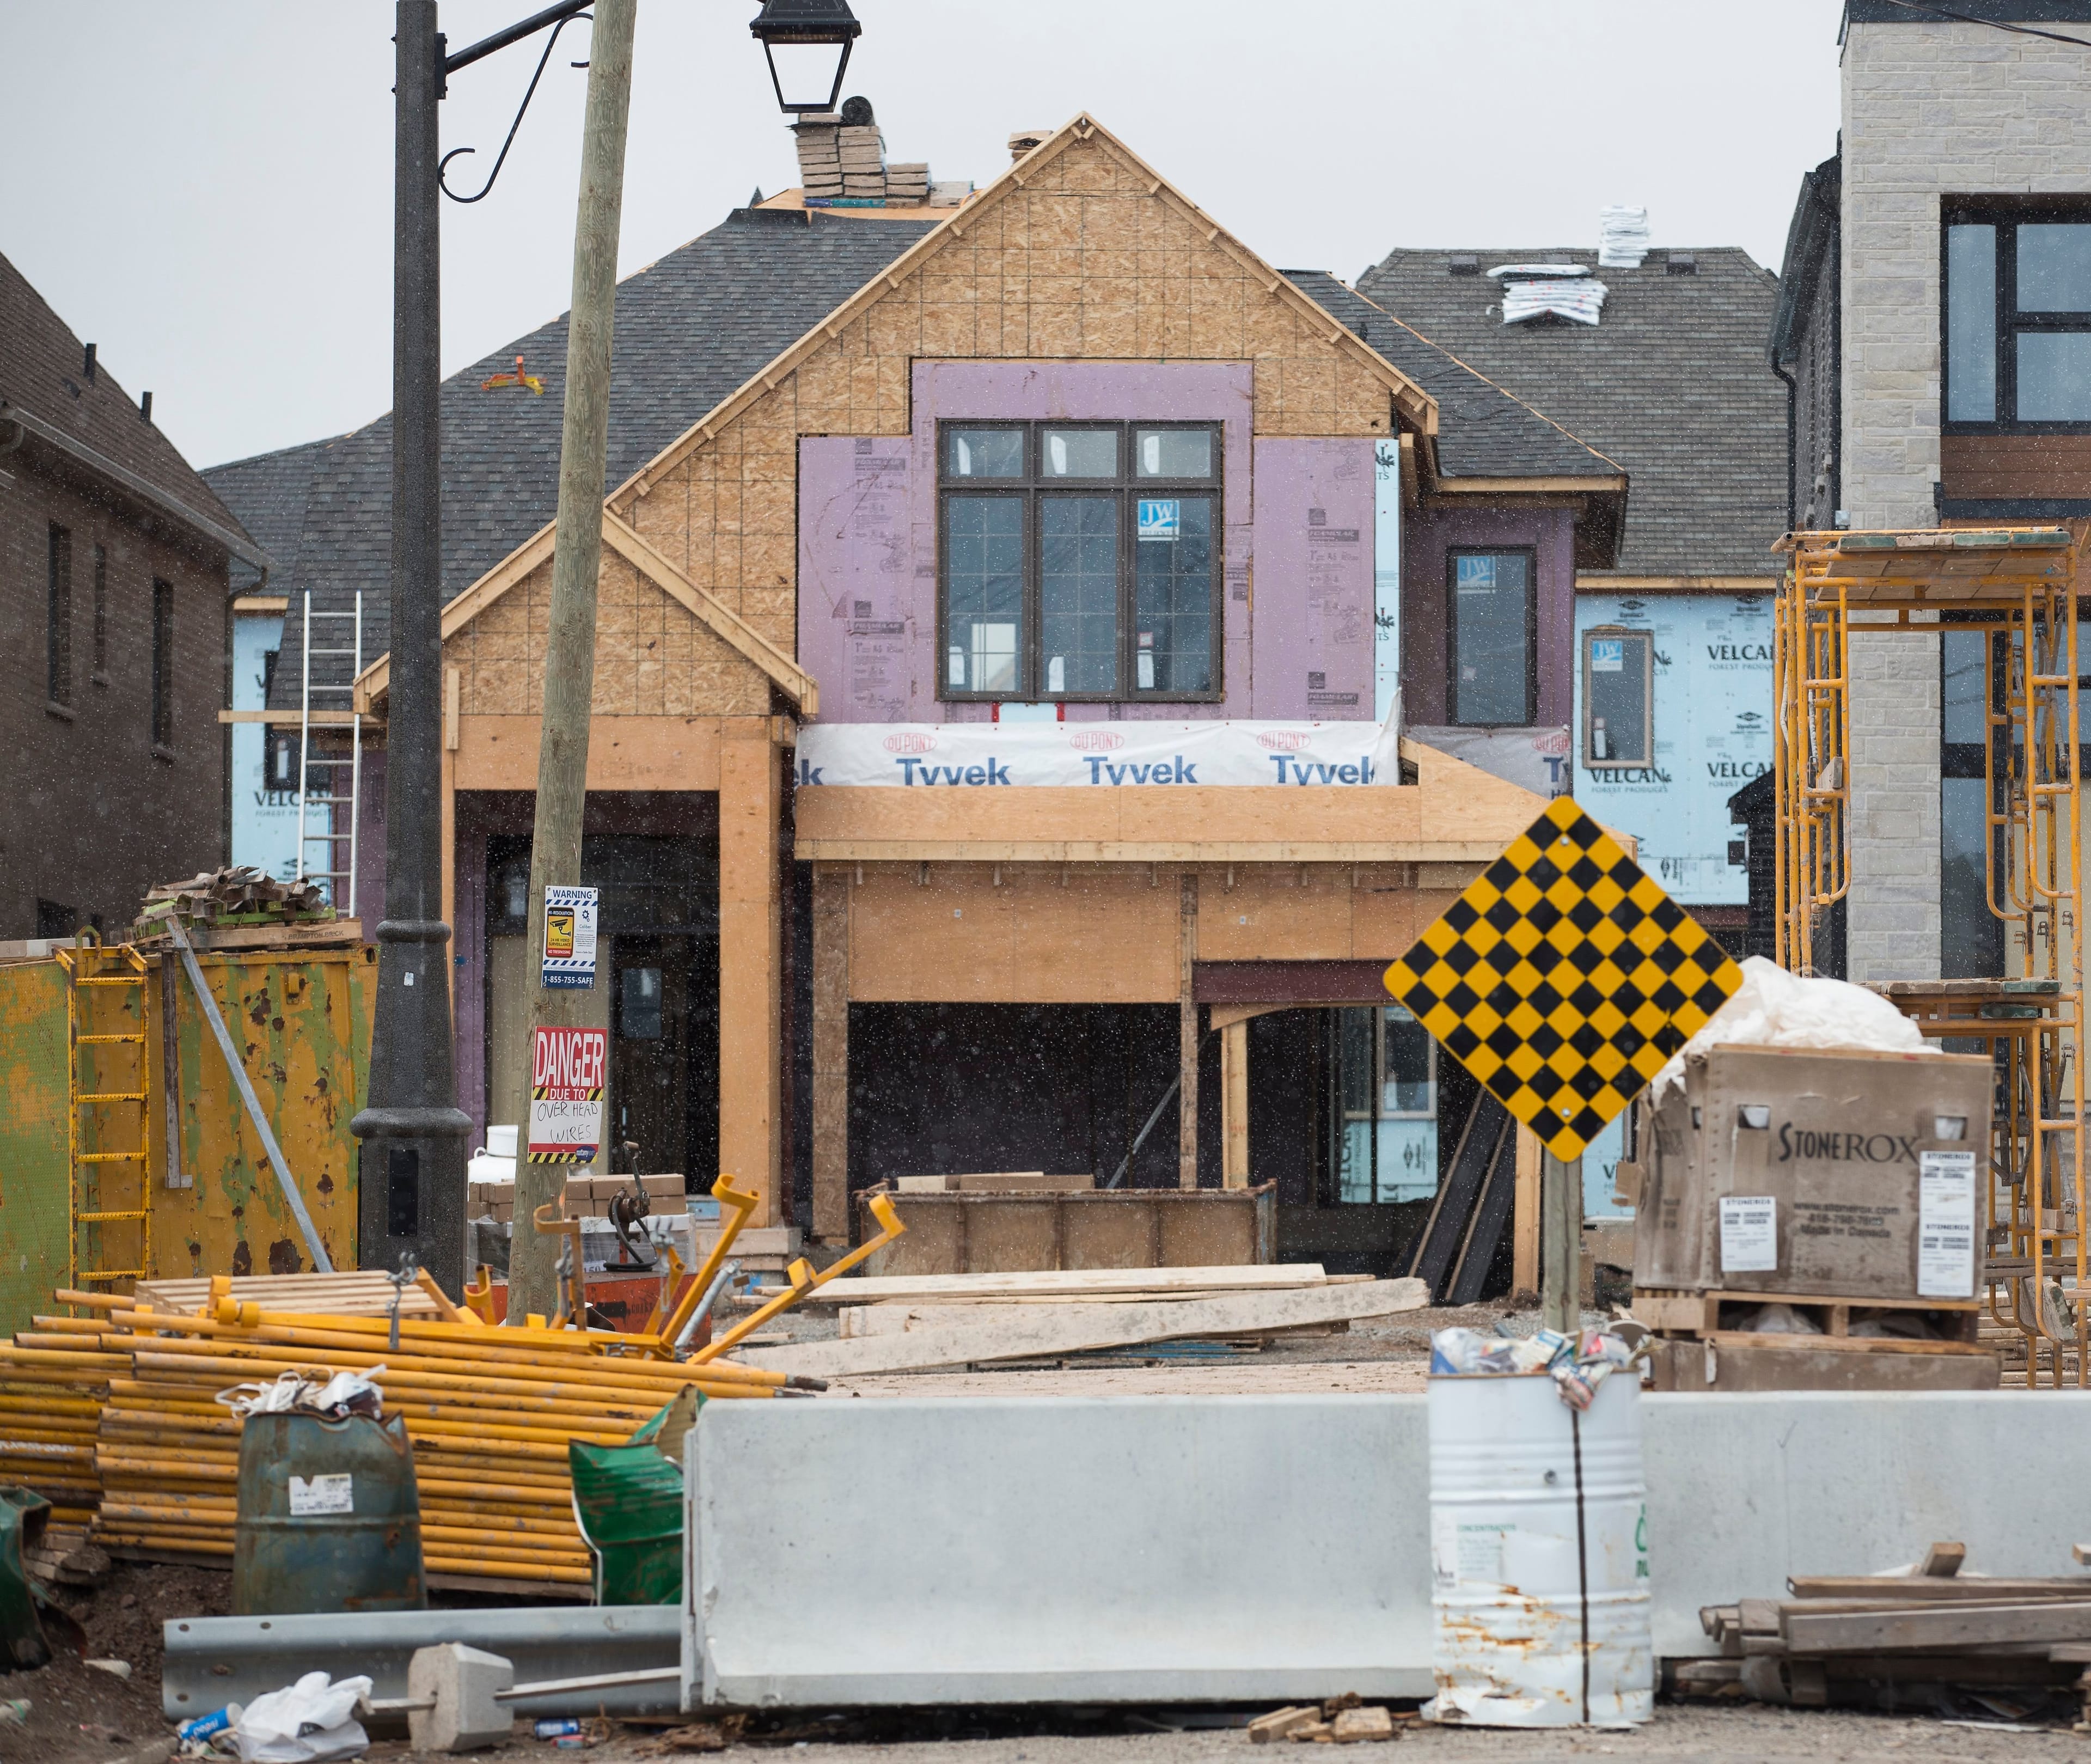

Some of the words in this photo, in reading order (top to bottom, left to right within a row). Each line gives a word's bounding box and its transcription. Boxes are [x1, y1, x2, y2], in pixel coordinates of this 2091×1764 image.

[1142, 504, 1173, 524] JW
[553, 889, 592, 899] WARNING
[544, 975, 593, 984] 1-855-755-SAFE
[535, 1032, 604, 1087] DANGER
[550, 1088, 570, 1100] DUE
[573, 1089, 586, 1101] TO
[537, 1101, 570, 1121] OVER
[573, 1102, 598, 1118] HEAD
[550, 1124, 591, 1144] WIRES
[1800, 1224, 1831, 1236] Made
[1833, 1226, 1844, 1235] in
[1848, 1226, 1891, 1238] Canada
